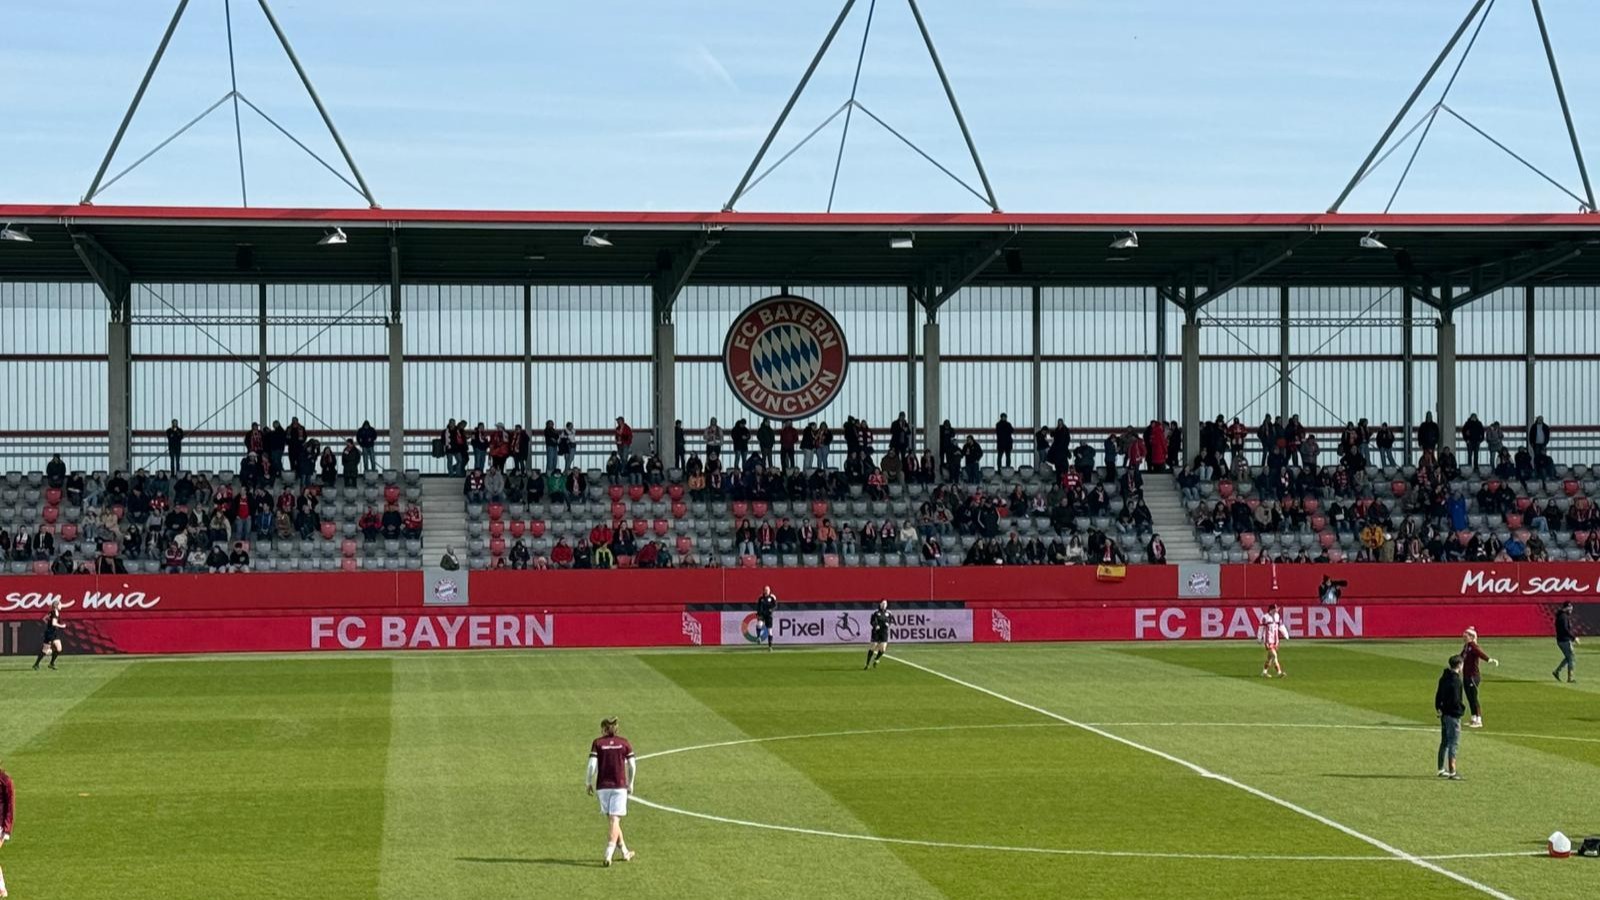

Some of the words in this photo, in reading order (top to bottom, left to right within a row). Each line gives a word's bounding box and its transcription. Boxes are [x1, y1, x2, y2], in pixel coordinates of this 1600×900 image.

[735, 322, 758, 350] FC
[759, 304, 837, 349] BAYERN
[736, 370, 837, 412] MÜNCHEN
[1461, 569, 1520, 595] Mia
[1522, 577, 1590, 595] san
[0, 592, 76, 611] san
[82, 583, 161, 609] mia
[311, 616, 367, 649] FC
[381, 614, 554, 648] BAYERN
[779, 618, 824, 636] Pixel
[889, 614, 931, 627] AUEN-
[889, 627, 957, 640] NDESLIGA
[1135, 607, 1188, 639] FC
[1201, 606, 1364, 638] BAERN
